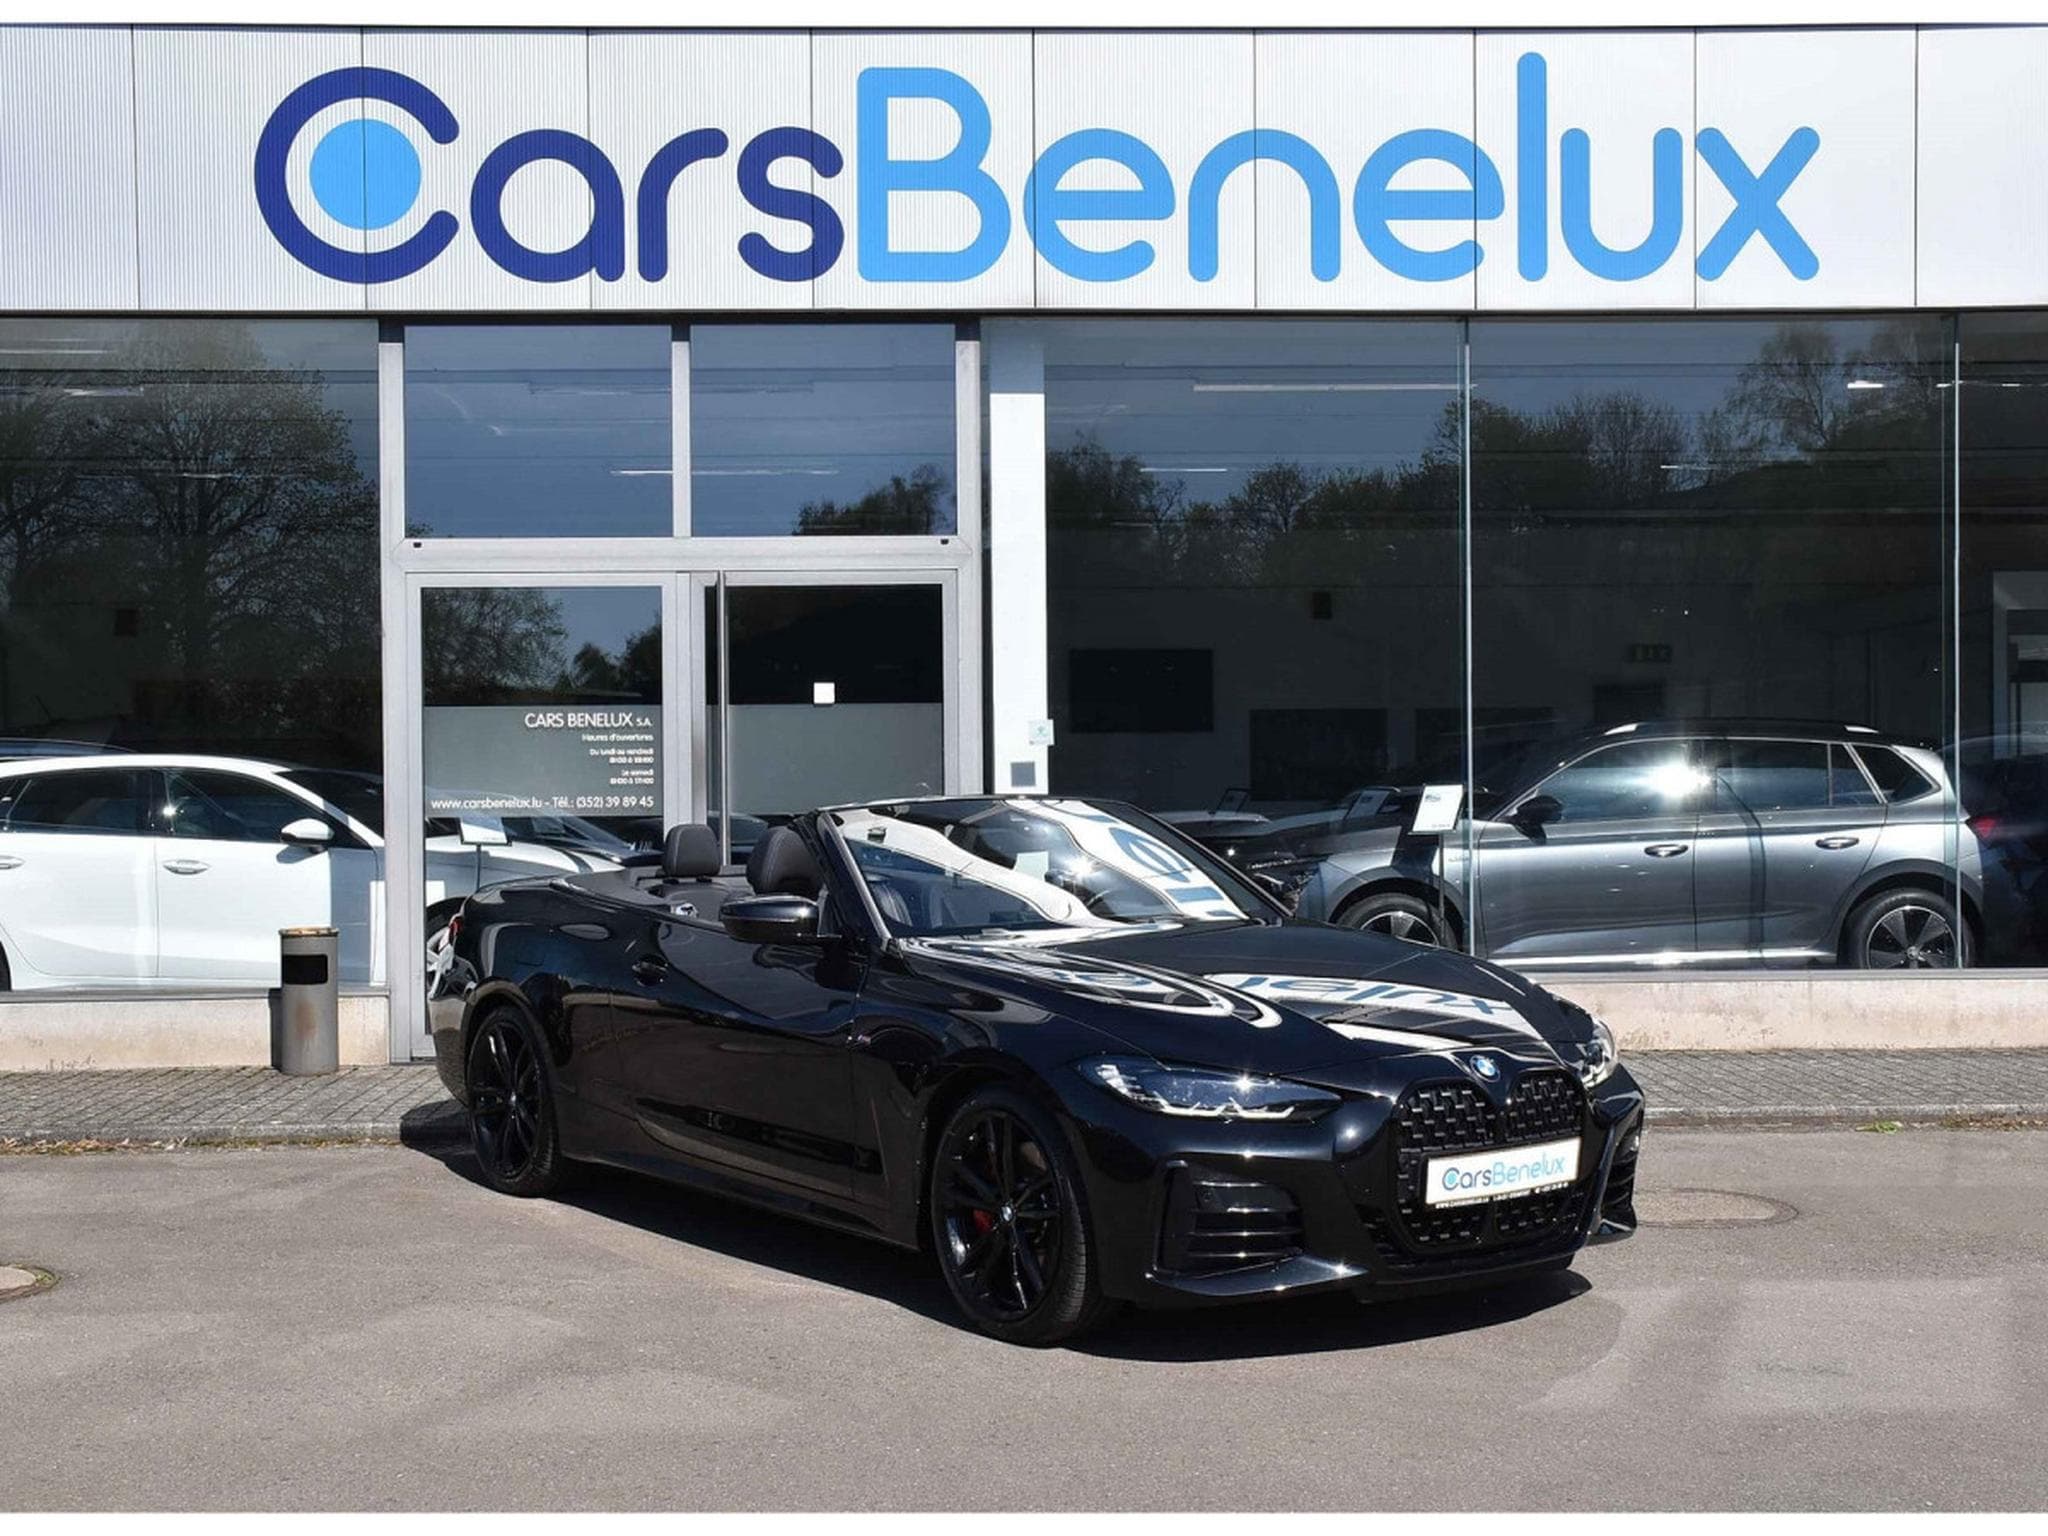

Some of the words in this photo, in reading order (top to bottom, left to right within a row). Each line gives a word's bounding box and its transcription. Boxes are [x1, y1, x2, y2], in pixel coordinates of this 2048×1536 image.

[254, 52, 1820, 283] CarsBenelux
[524, 712, 565, 728] CARS
[567, 712, 633, 728] BENELUX
[431, 796, 542, 809] www.carsbenelux.lu
[576, 796, 603, 809] (352)
[605, 796, 620, 808] 39
[622, 796, 637, 808] 89
[639, 796, 654, 808] 45
[1441, 1151, 1566, 1191] CarsBenelux
